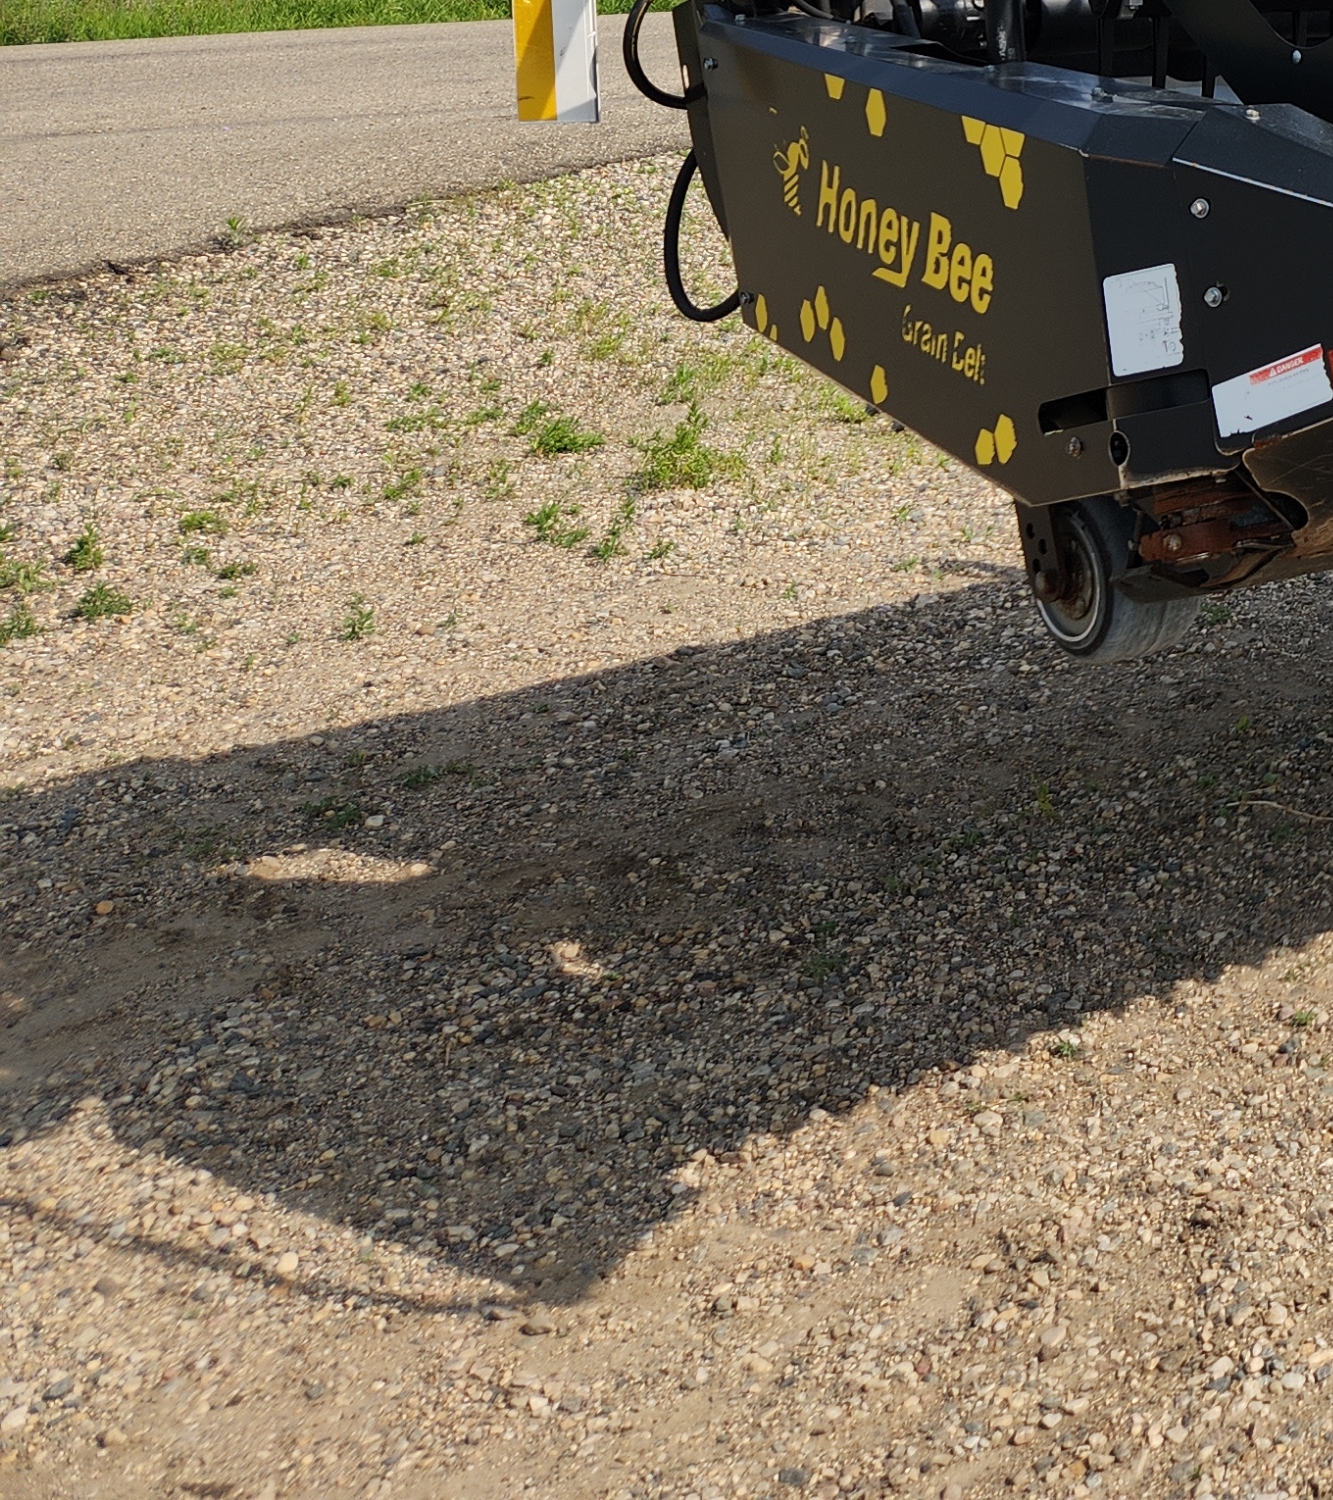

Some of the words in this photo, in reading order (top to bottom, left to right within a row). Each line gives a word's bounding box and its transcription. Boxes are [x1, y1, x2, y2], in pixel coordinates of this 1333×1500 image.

[816, 160, 920, 288] Honey
[921, 212, 994, 314] Bee
[901, 304, 948, 363] Grain
[1276, 356, 1304, 373] DANGER
